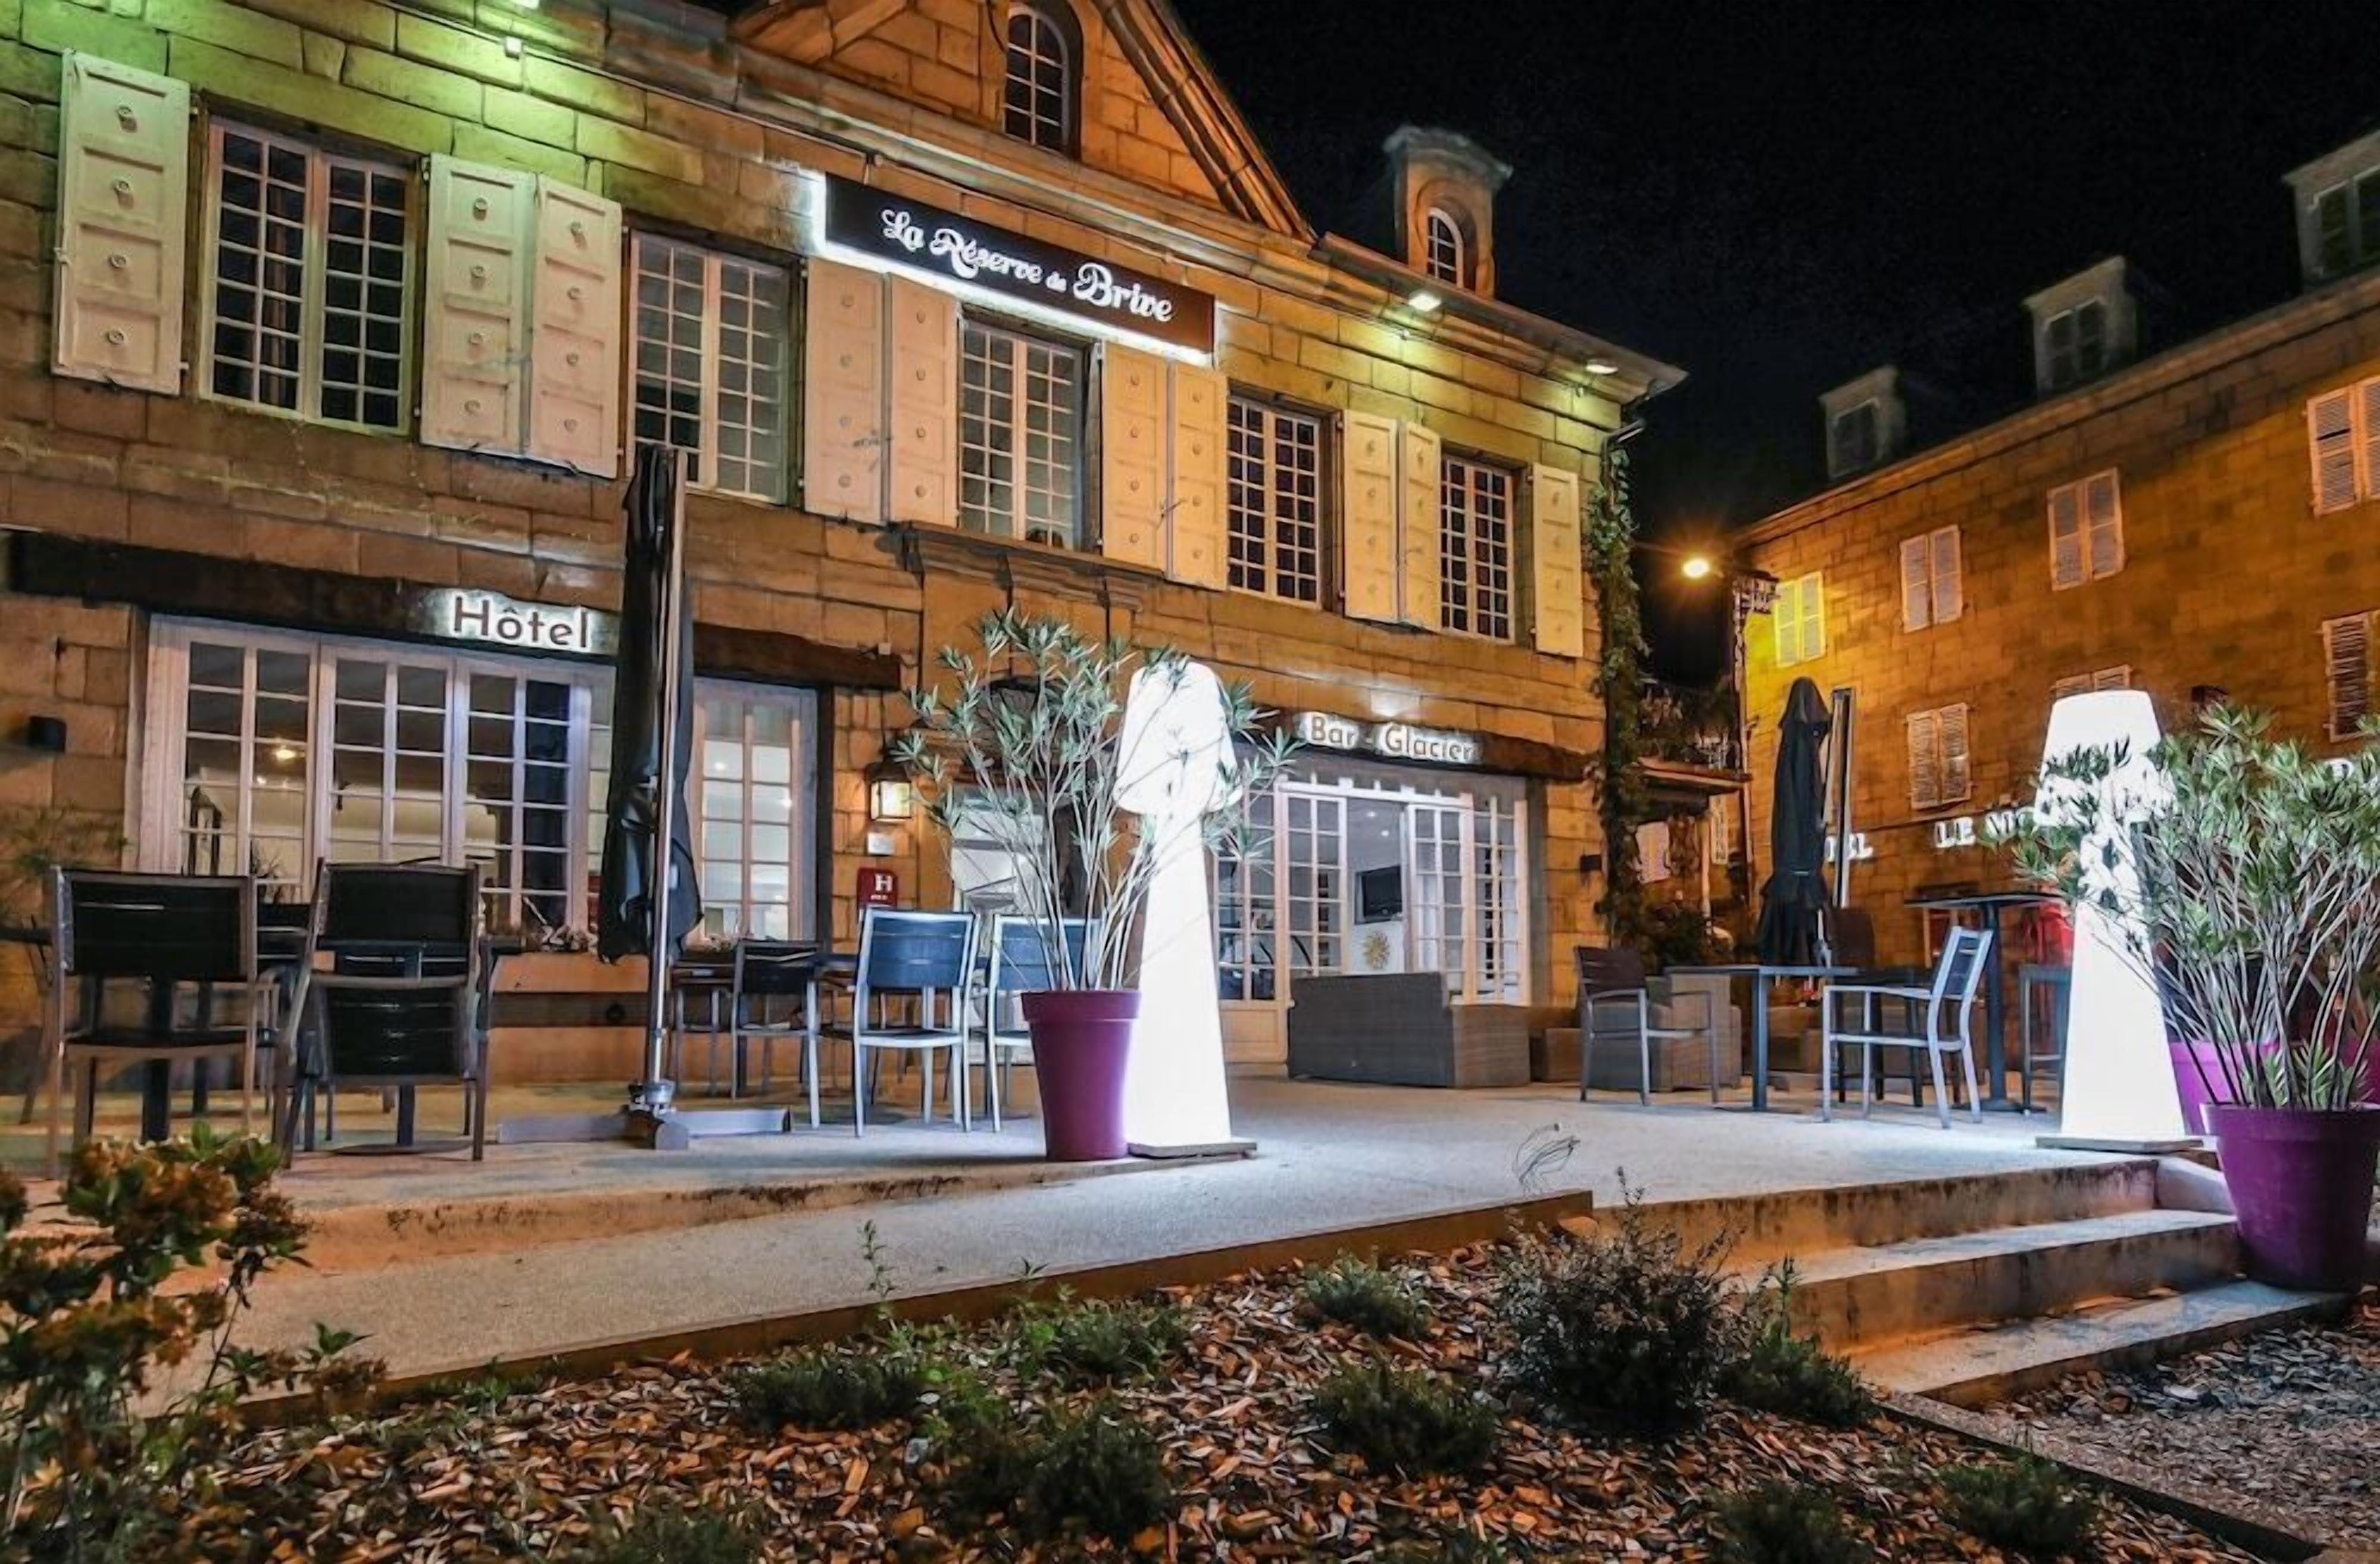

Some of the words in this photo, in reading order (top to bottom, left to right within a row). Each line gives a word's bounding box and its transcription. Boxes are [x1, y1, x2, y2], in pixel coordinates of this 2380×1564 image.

[882, 209, 924, 251] La
[930, 229, 1042, 284] Réserve
[1073, 262, 1172, 321] Brive
[453, 596, 587, 648] Hôtel
[1311, 717, 1358, 747] Bar
[1385, 725, 1473, 761] Glacier
[875, 874, 892, 892] H
